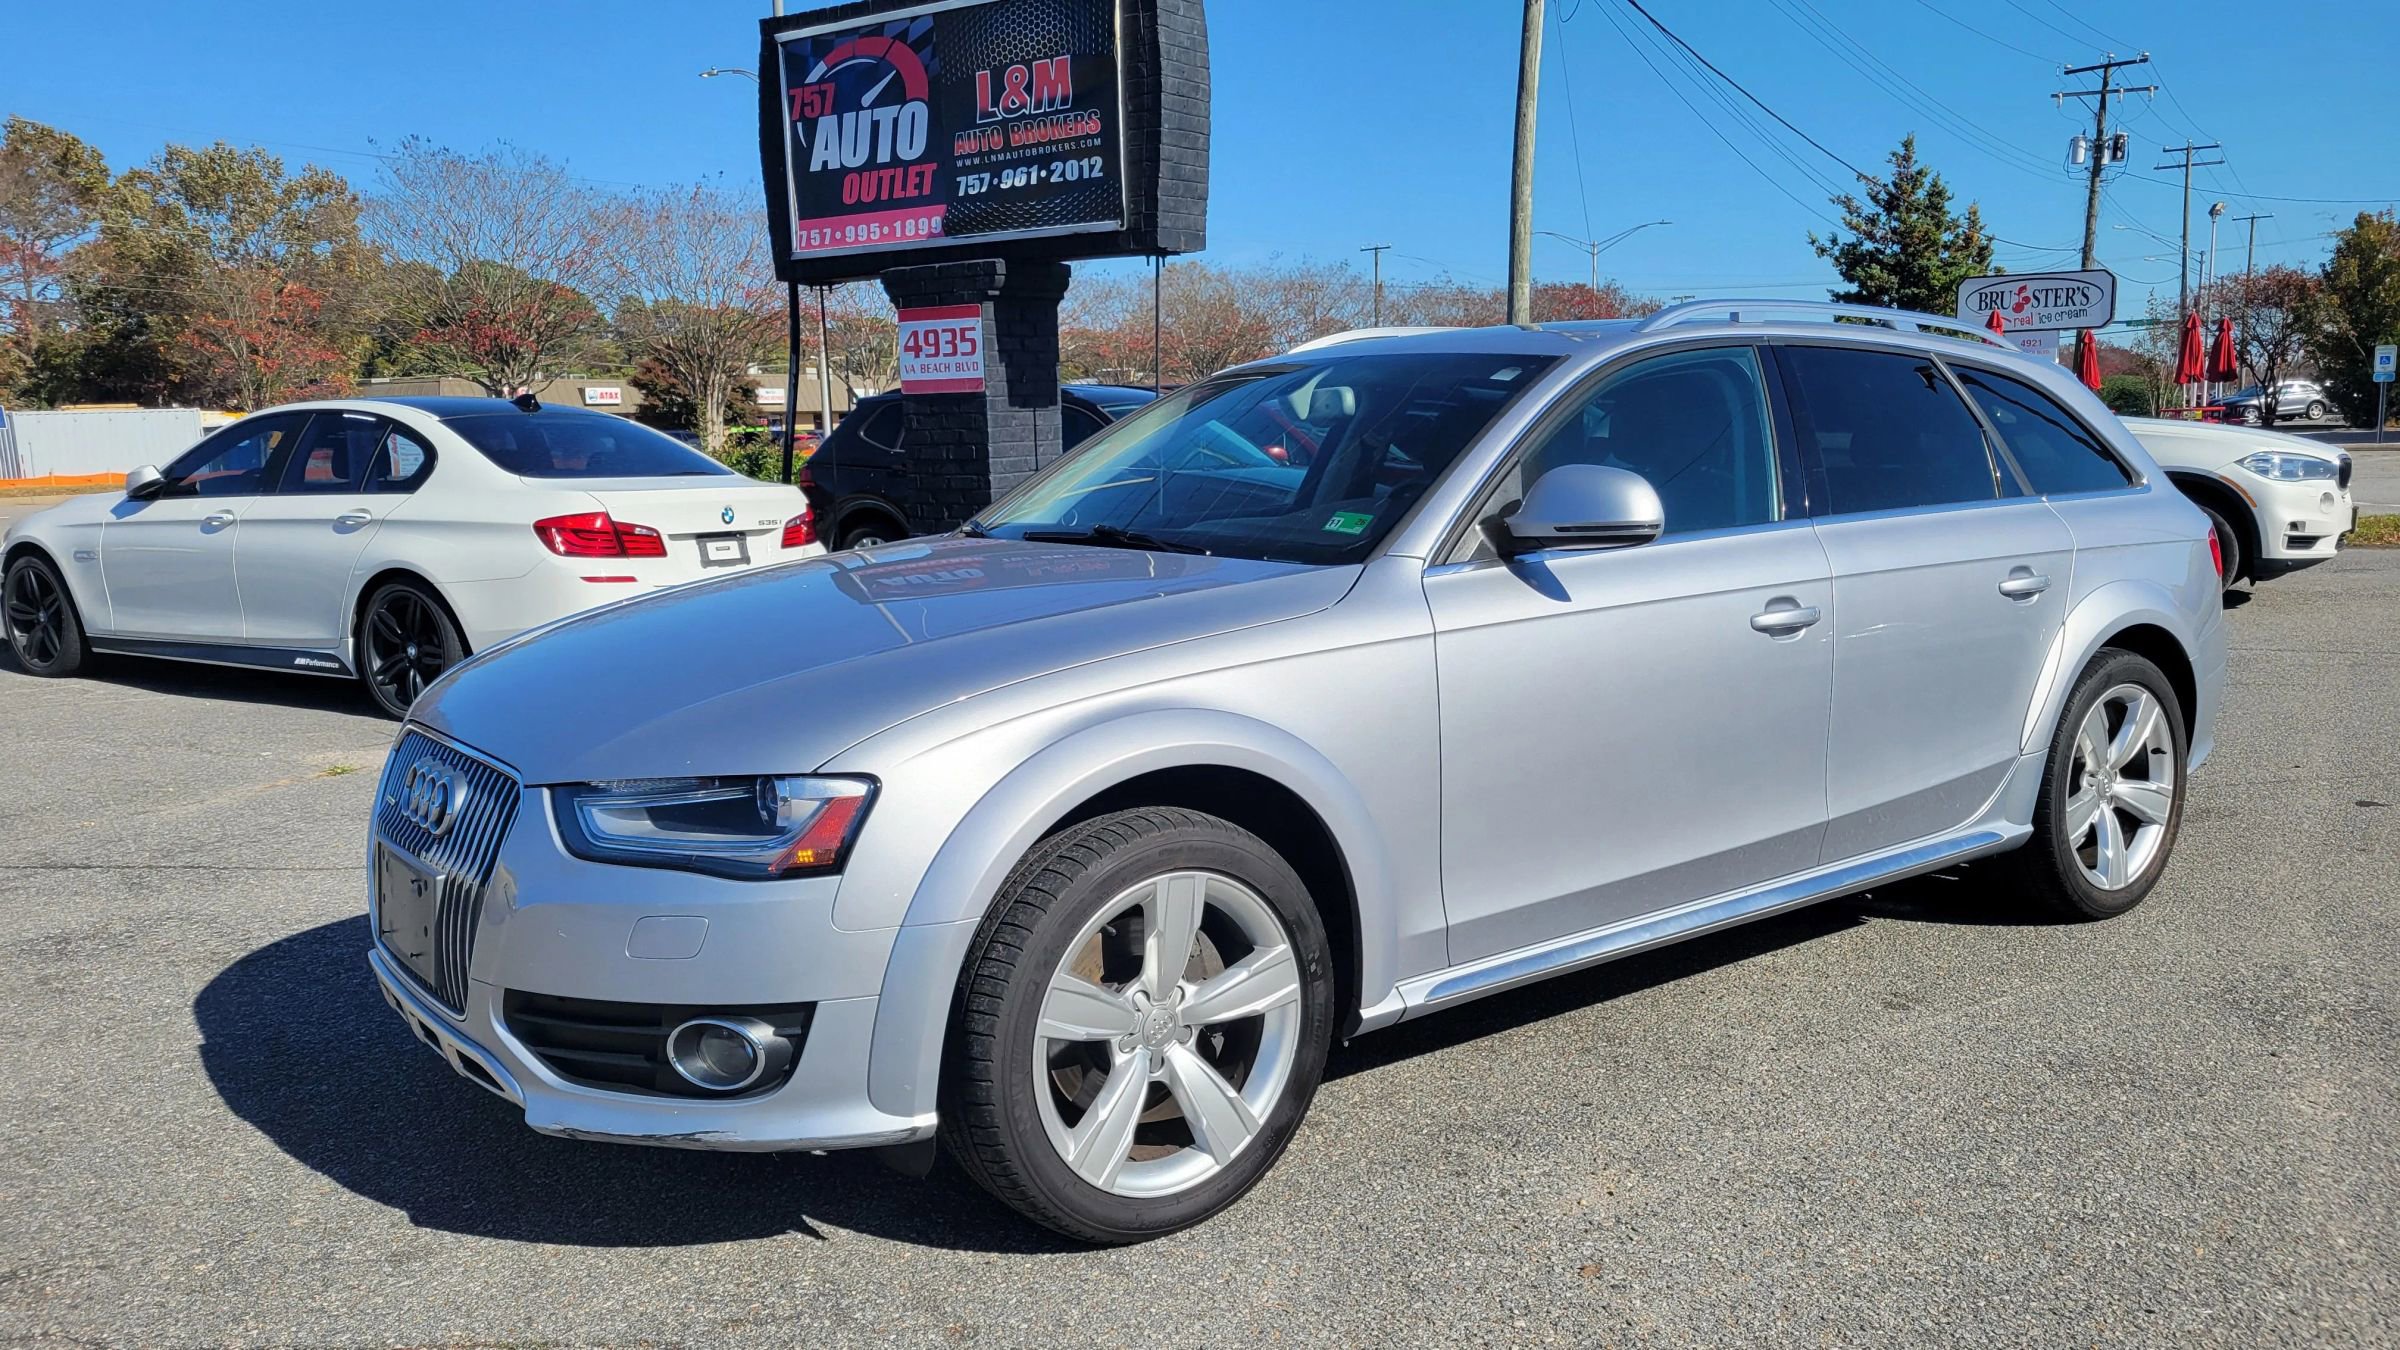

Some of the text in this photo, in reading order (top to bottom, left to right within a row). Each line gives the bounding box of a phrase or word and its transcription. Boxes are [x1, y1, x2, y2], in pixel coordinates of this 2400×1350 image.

[789, 83, 835, 120] 757
[976, 55, 1072, 124] L&M
[809, 101, 928, 172] AUTO
[954, 109, 1101, 156] AUTO BROKERS
[956, 137, 1102, 168] WWW.LNMAUTOBROKERS.COM
[842, 163, 937, 205] OUTLET
[2013, 308, 2088, 328] real ice cream
[903, 326, 977, 359] 4935
[2020, 339, 2042, 348] 4921
[904, 361, 979, 375] VA BEACH BLVD
[599, 391, 619, 400] ATAX
